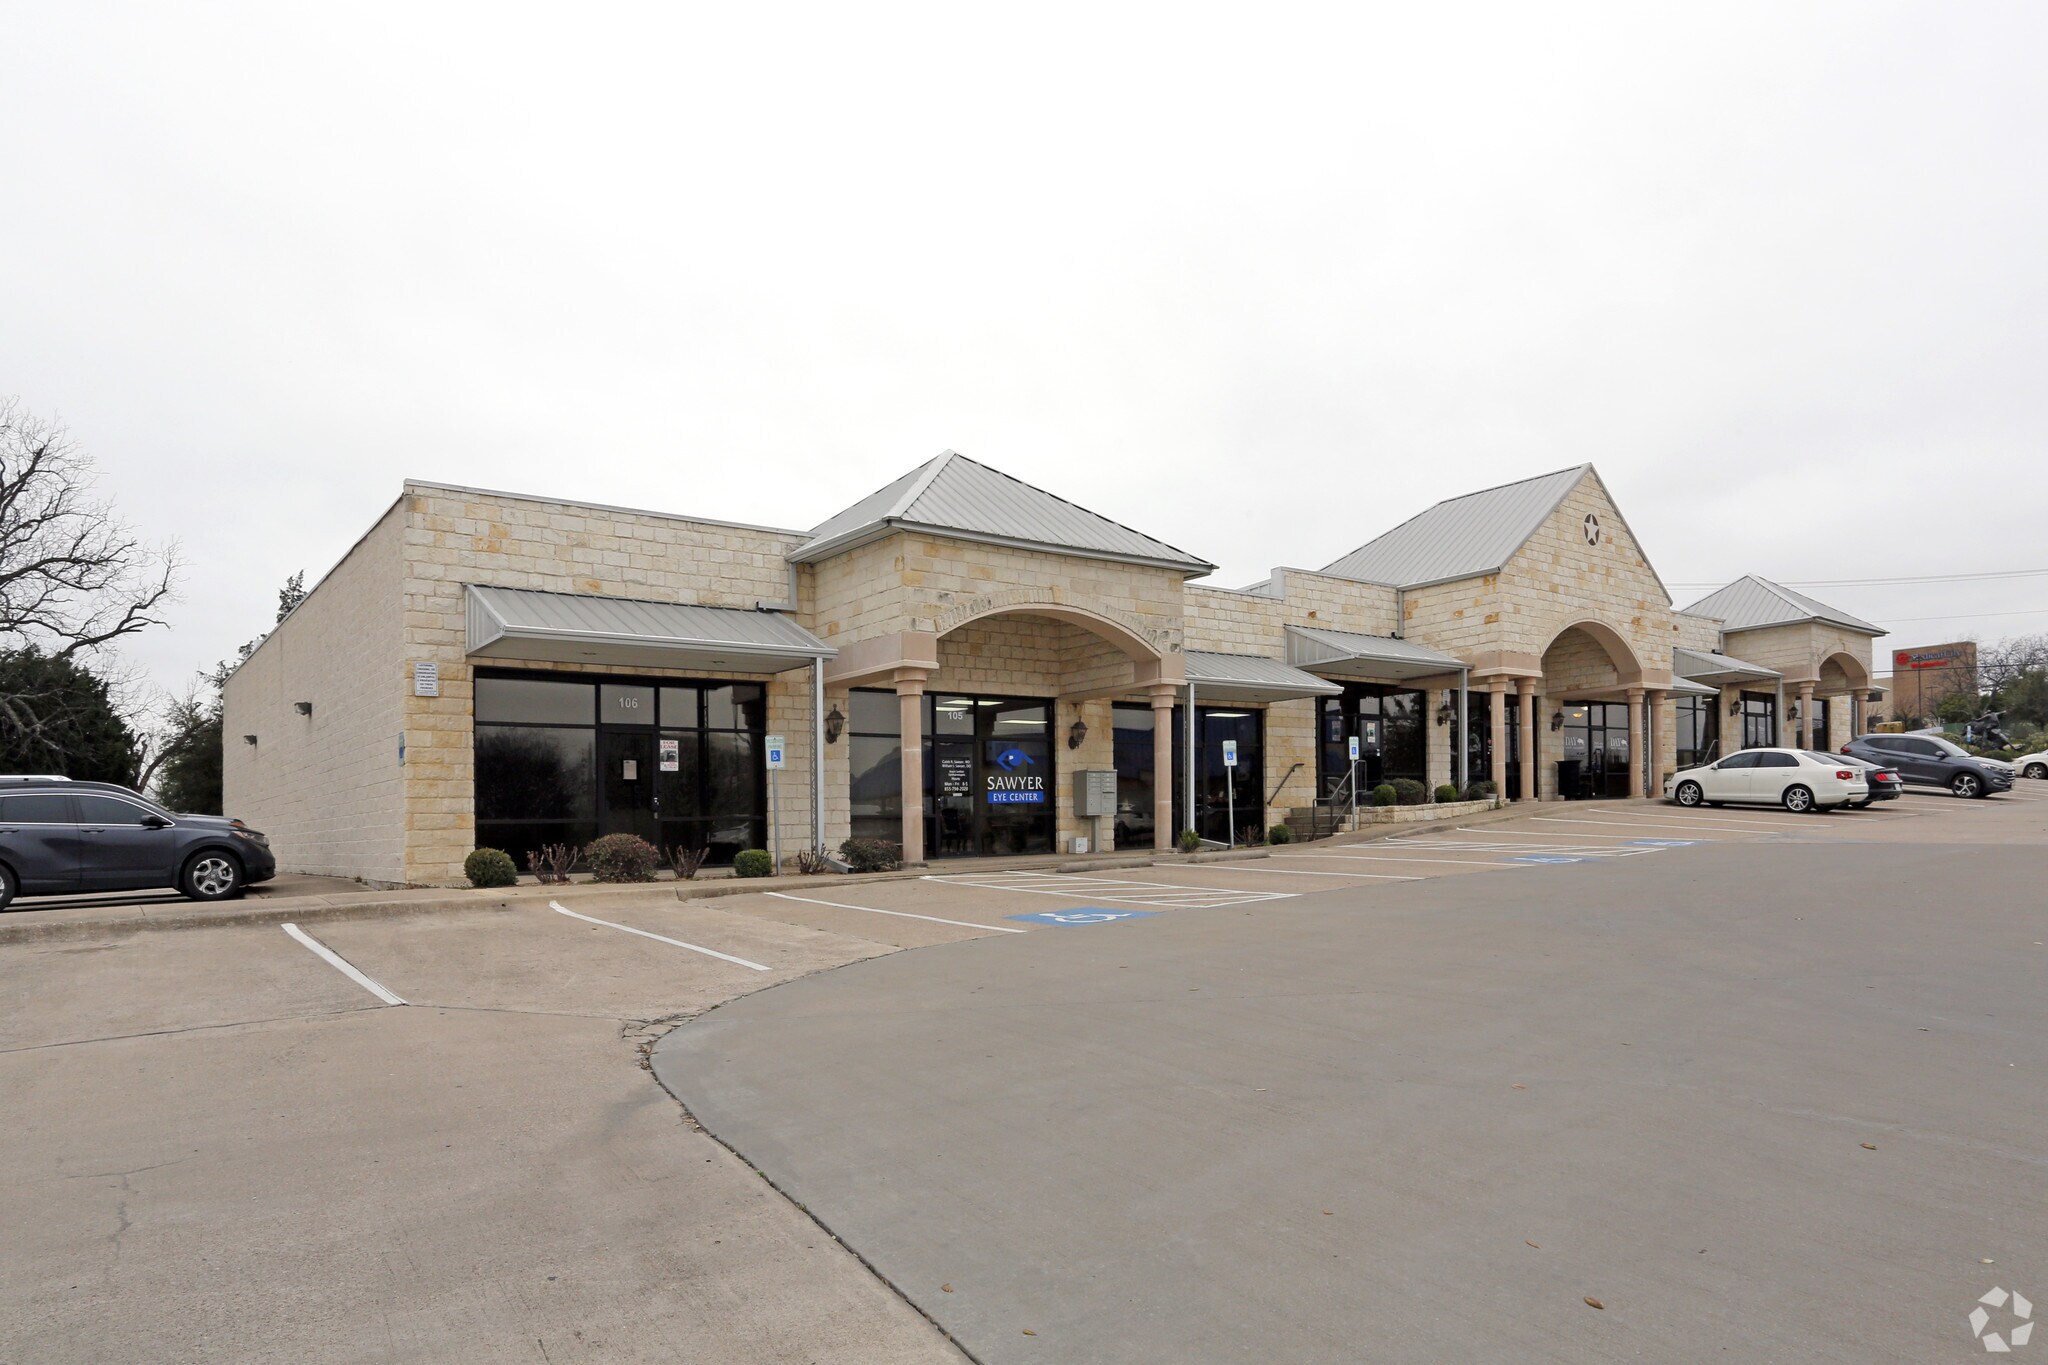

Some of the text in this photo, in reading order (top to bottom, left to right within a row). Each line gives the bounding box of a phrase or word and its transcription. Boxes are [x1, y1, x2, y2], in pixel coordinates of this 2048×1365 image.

[619, 697, 638, 708] 106
[948, 711, 963, 720] 105
[1565, 736, 1577, 746] DAY
[987, 776, 1044, 790] SAWYER
[993, 793, 1039, 802] EYE CENTER
